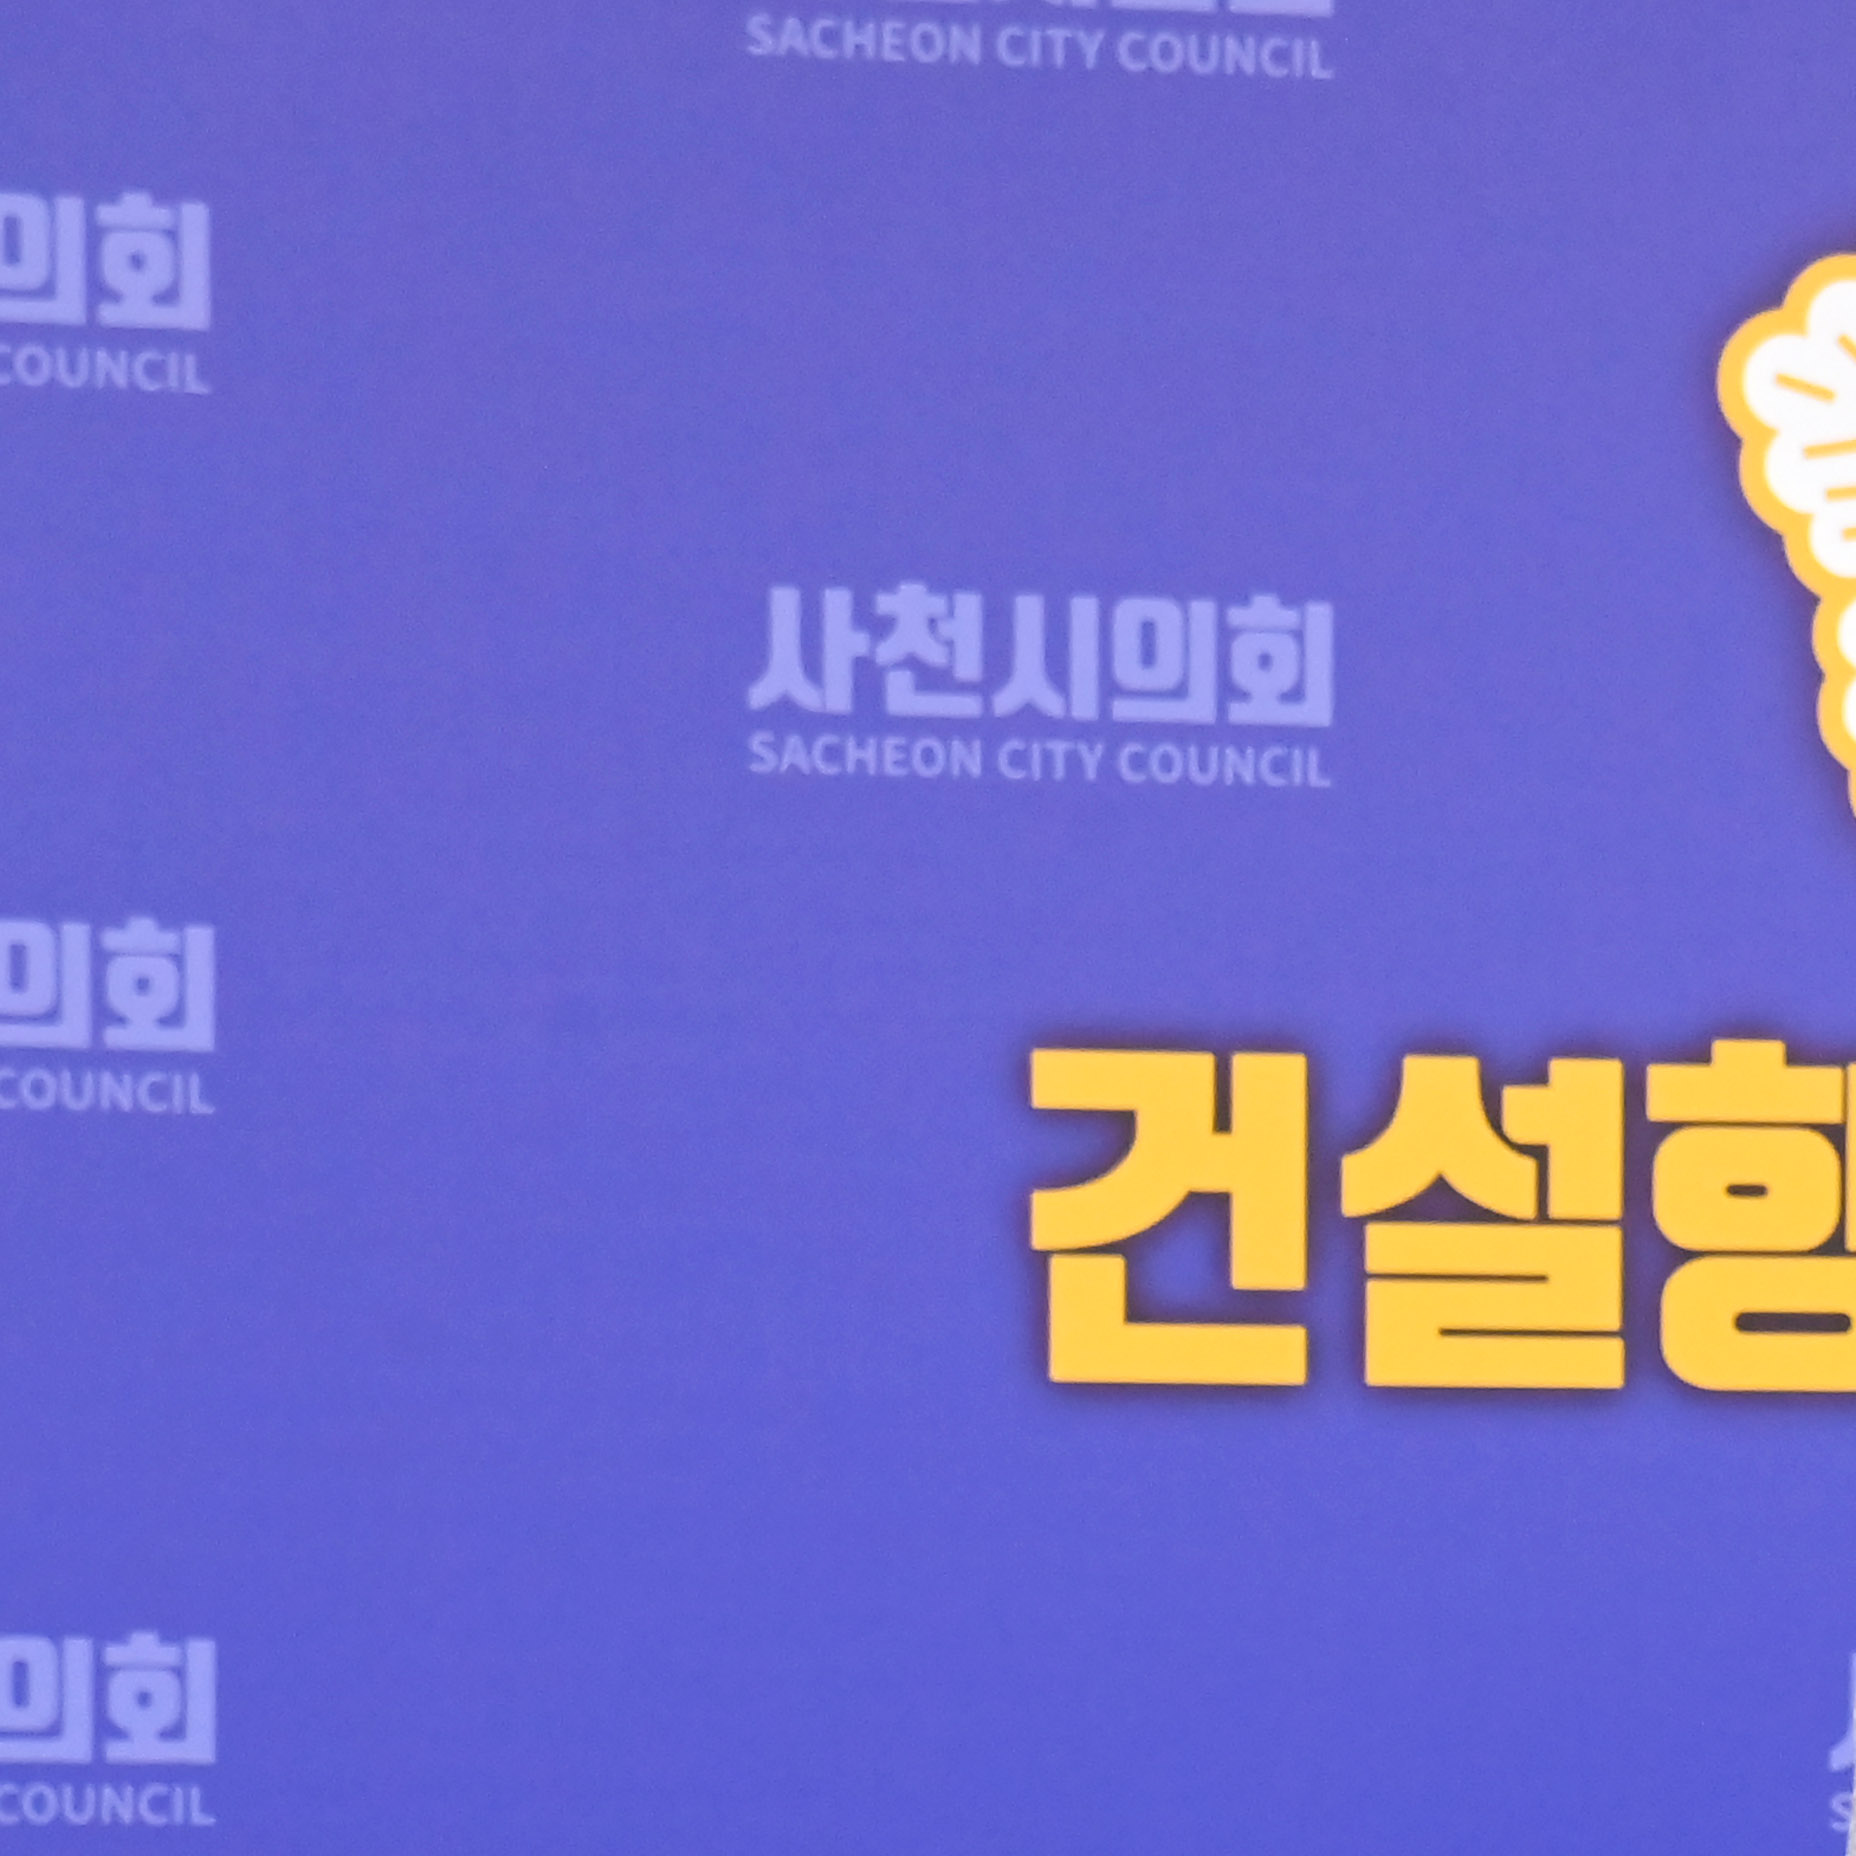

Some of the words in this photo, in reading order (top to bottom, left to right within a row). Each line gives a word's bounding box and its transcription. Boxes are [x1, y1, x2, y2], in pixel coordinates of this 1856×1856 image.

[746, 14, 981, 63] SACHEON
[997, 27, 1104, 68] CITY
[1117, 32, 1333, 79] COUNCIL
[746, 580, 1335, 728] 사천시의회
[748, 731, 982, 778] SACHEON
[997, 738, 1104, 781] CITY
[1117, 742, 1332, 788] COUNCIL
